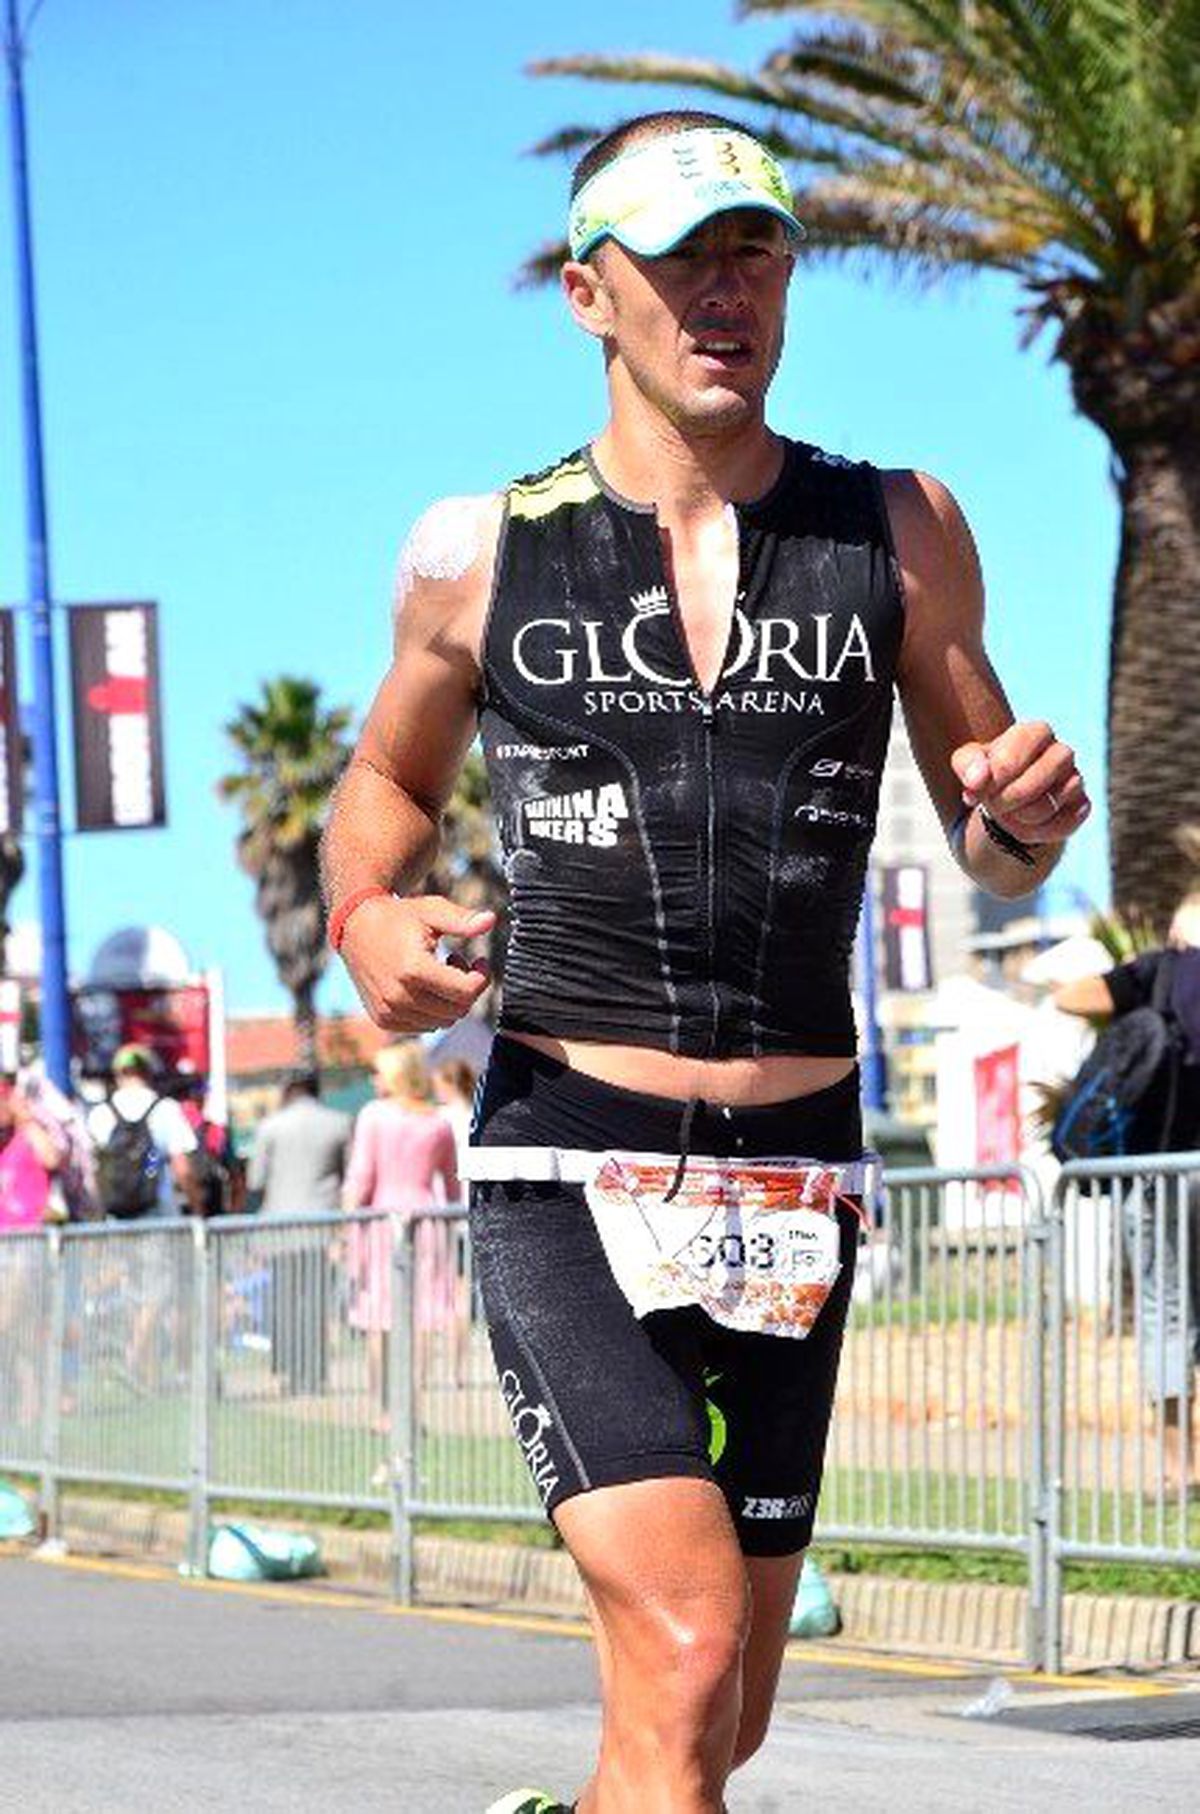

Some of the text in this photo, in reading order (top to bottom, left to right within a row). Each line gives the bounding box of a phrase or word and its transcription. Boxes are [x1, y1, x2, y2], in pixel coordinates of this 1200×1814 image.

[512, 610, 876, 687] GLORIA
[583, 690, 826, 716] SPORTS ARENA
